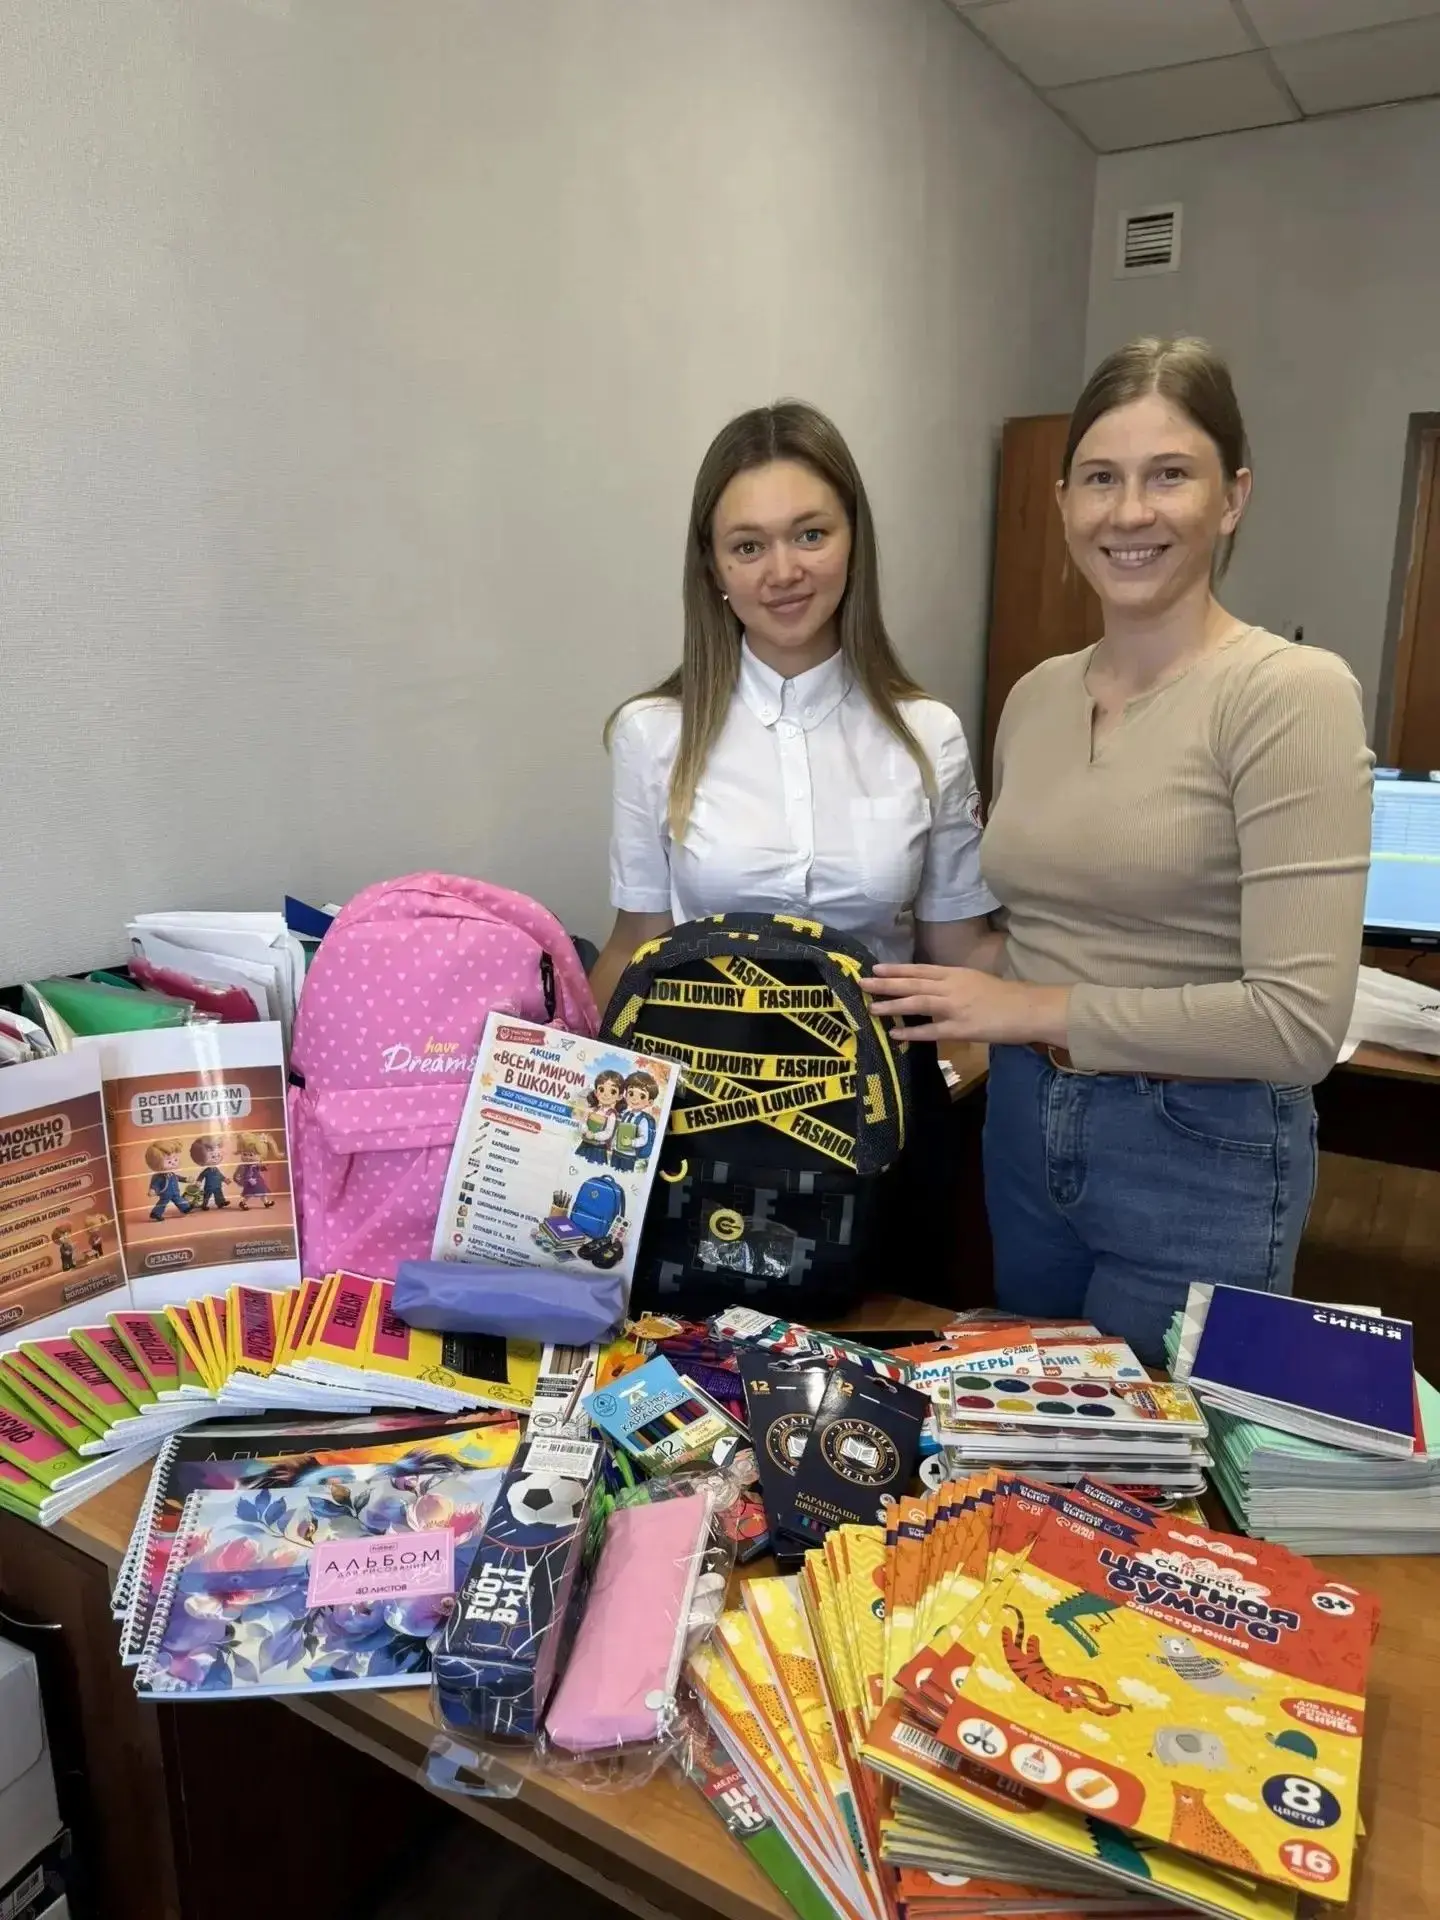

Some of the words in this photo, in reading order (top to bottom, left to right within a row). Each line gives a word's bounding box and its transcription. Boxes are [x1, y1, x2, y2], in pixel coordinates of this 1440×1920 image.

[684, 984, 746, 1008] LUXURY
[759, 988, 834, 1009] FASHION
[790, 1012, 852, 1048] UXURY
[424, 1036, 459, 1054] have
[529, 1047, 561, 1062] АКЦИЯ
[493, 1050, 535, 1073] «ВСЕМ
[538, 1061, 586, 1087] МИРОМ
[697, 1052, 765, 1077] LUXURY
[775, 1058, 851, 1078] FASHION
[504, 1069, 514, 1084] В
[517, 1072, 571, 1100] ШКОЛУ»
[138, 1092, 180, 1109] ВСЕМ
[684, 1097, 760, 1129] FASHION
[762, 1080, 827, 1113] LUXURY
[140, 1108, 153, 1125] В
[0, 1117, 64, 1147] МОЖНО
[332, 1290, 365, 1329] ENGLISH
[1313, 1314, 1402, 1341] СИНЯЯ
[54, 1351, 110, 1387] ИСТОРИЯ
[750, 1380, 770, 1391] 12
[836, 1379, 855, 1396] 12
[772, 1417, 810, 1434] ЗНАН
[835, 1421, 895, 1453] ЗНАНИЯ
[655, 1440, 681, 1457] 12
[833, 1460, 876, 1483] СИЛА
[794, 1500, 840, 1522] ЦВЕТНЫЕ
[797, 1490, 861, 1522] КАРАНДАШИ
[325, 1549, 440, 1574] АЛЬБОМ
[363, 1563, 427, 1575] РИСОВАНИЯ
[1155, 1558, 1247, 1595] Calligrata
[356, 1586, 369, 1595] 40
[370, 1584, 408, 1593] ЛИСТОВ
[465, 1562, 507, 1621] FOOT
[1316, 1594, 1351, 1613] 3+
[712, 1771, 742, 1792] МЕЛО
[1281, 1778, 1322, 1814] 8
[1284, 1843, 1332, 1874] 16
